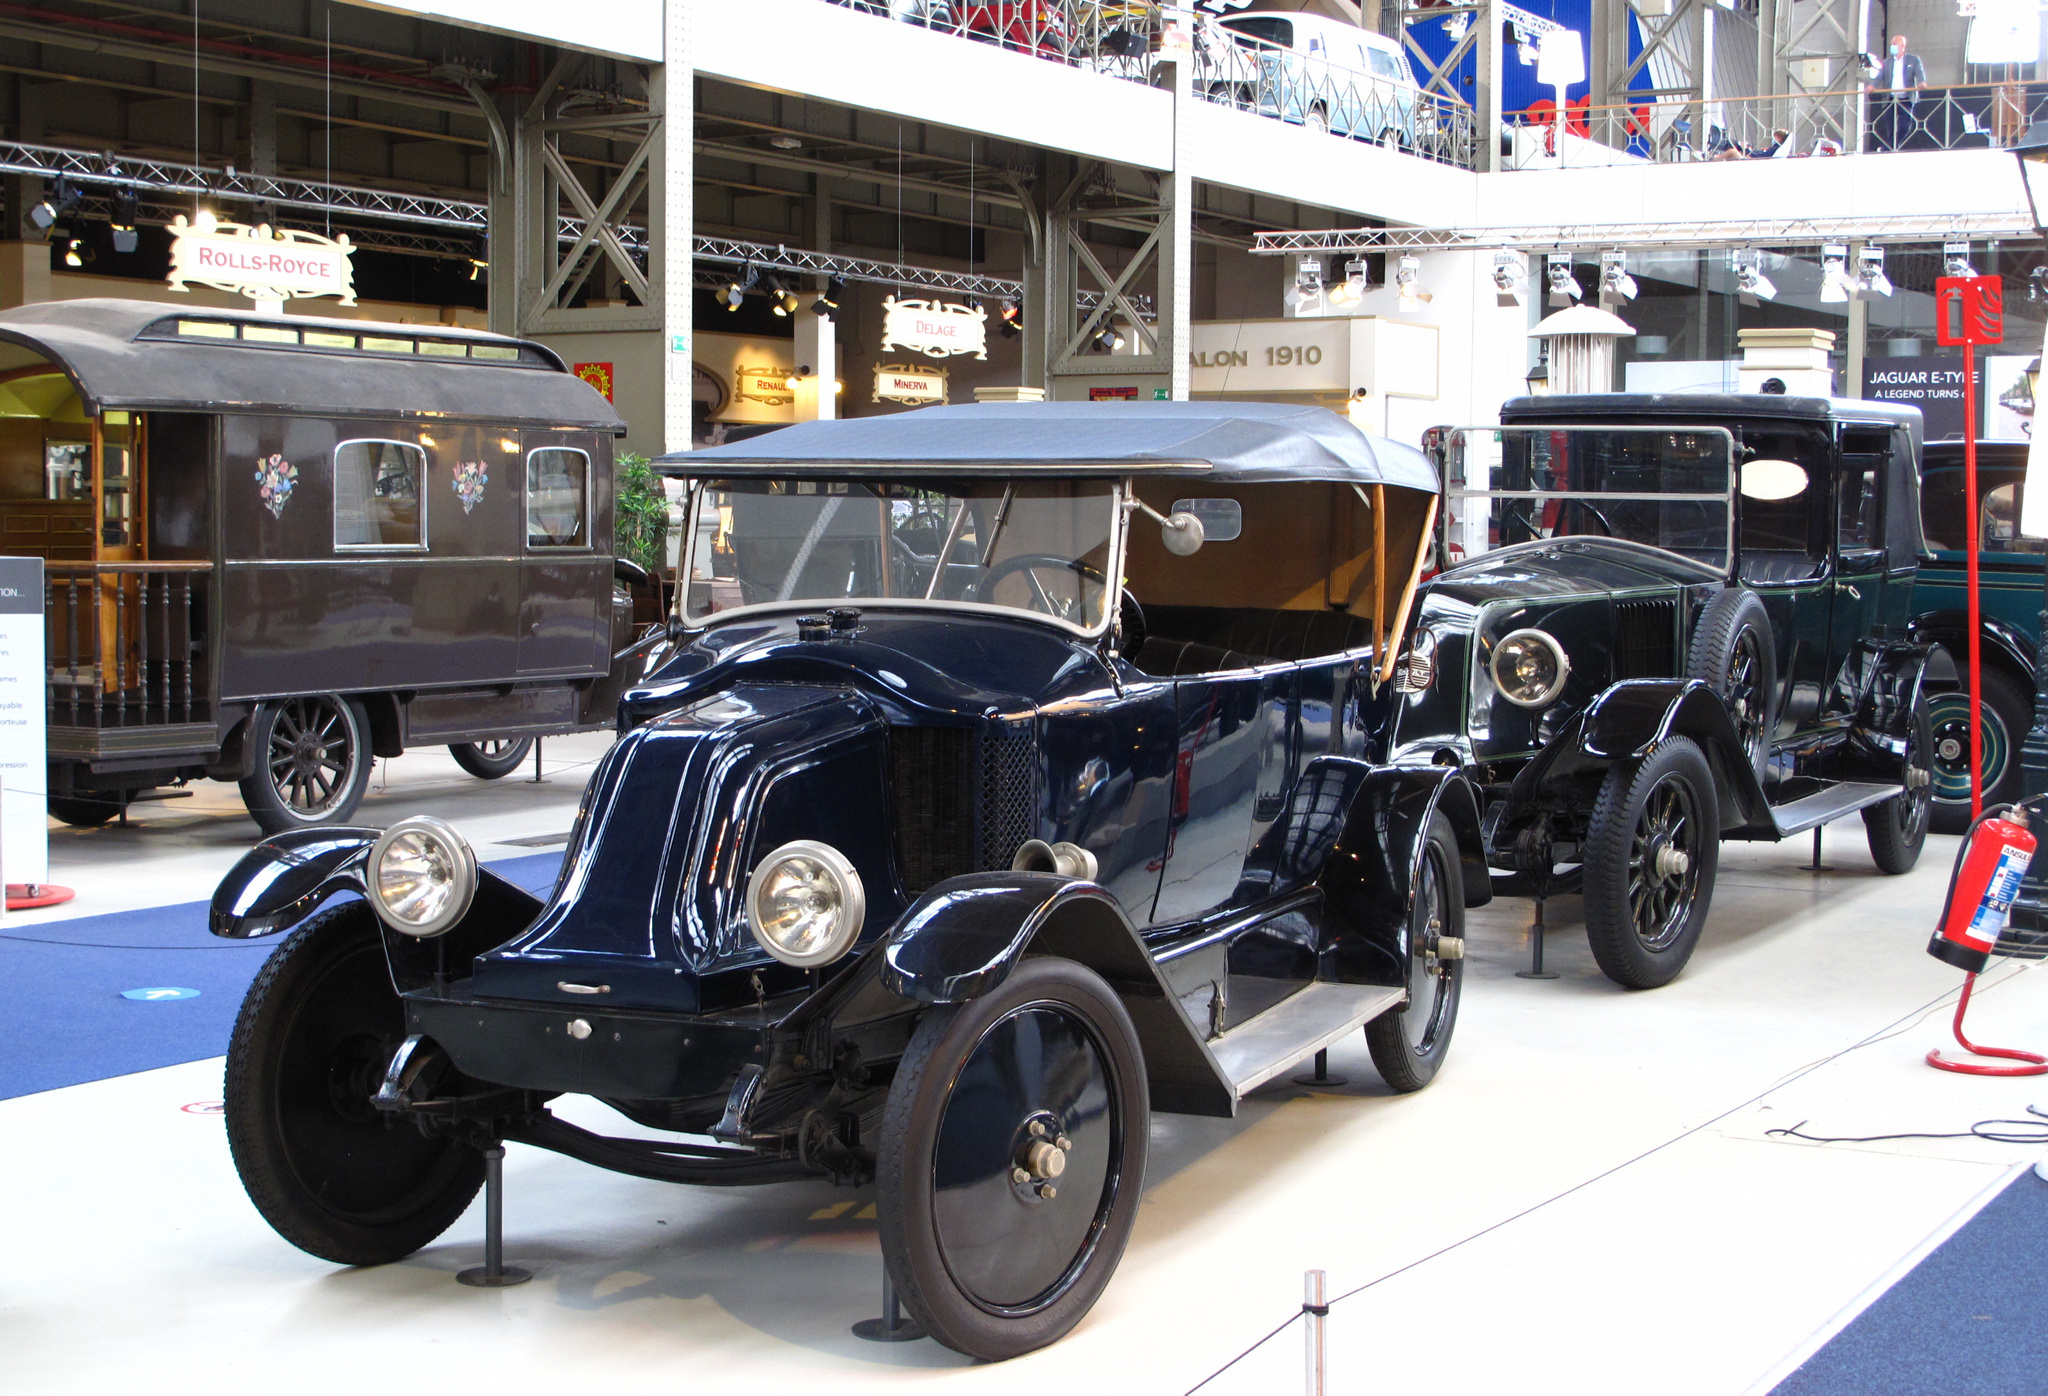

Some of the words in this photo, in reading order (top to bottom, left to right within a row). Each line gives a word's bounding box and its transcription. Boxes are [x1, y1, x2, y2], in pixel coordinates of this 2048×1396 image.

[199, 246, 331, 278] ROLLS-ROYCE
[916, 320, 957, 337] DELAGE
[1265, 345, 1323, 367] 1910
[1869, 371, 1928, 384] JAGUAR
[756, 379, 792, 392] RENAUL
[893, 378, 928, 391] MINERVA
[1874, 389, 1883, 399] A
[1884, 389, 1925, 399] LEGEND
[1926, 389, 1959, 399] TURNS
